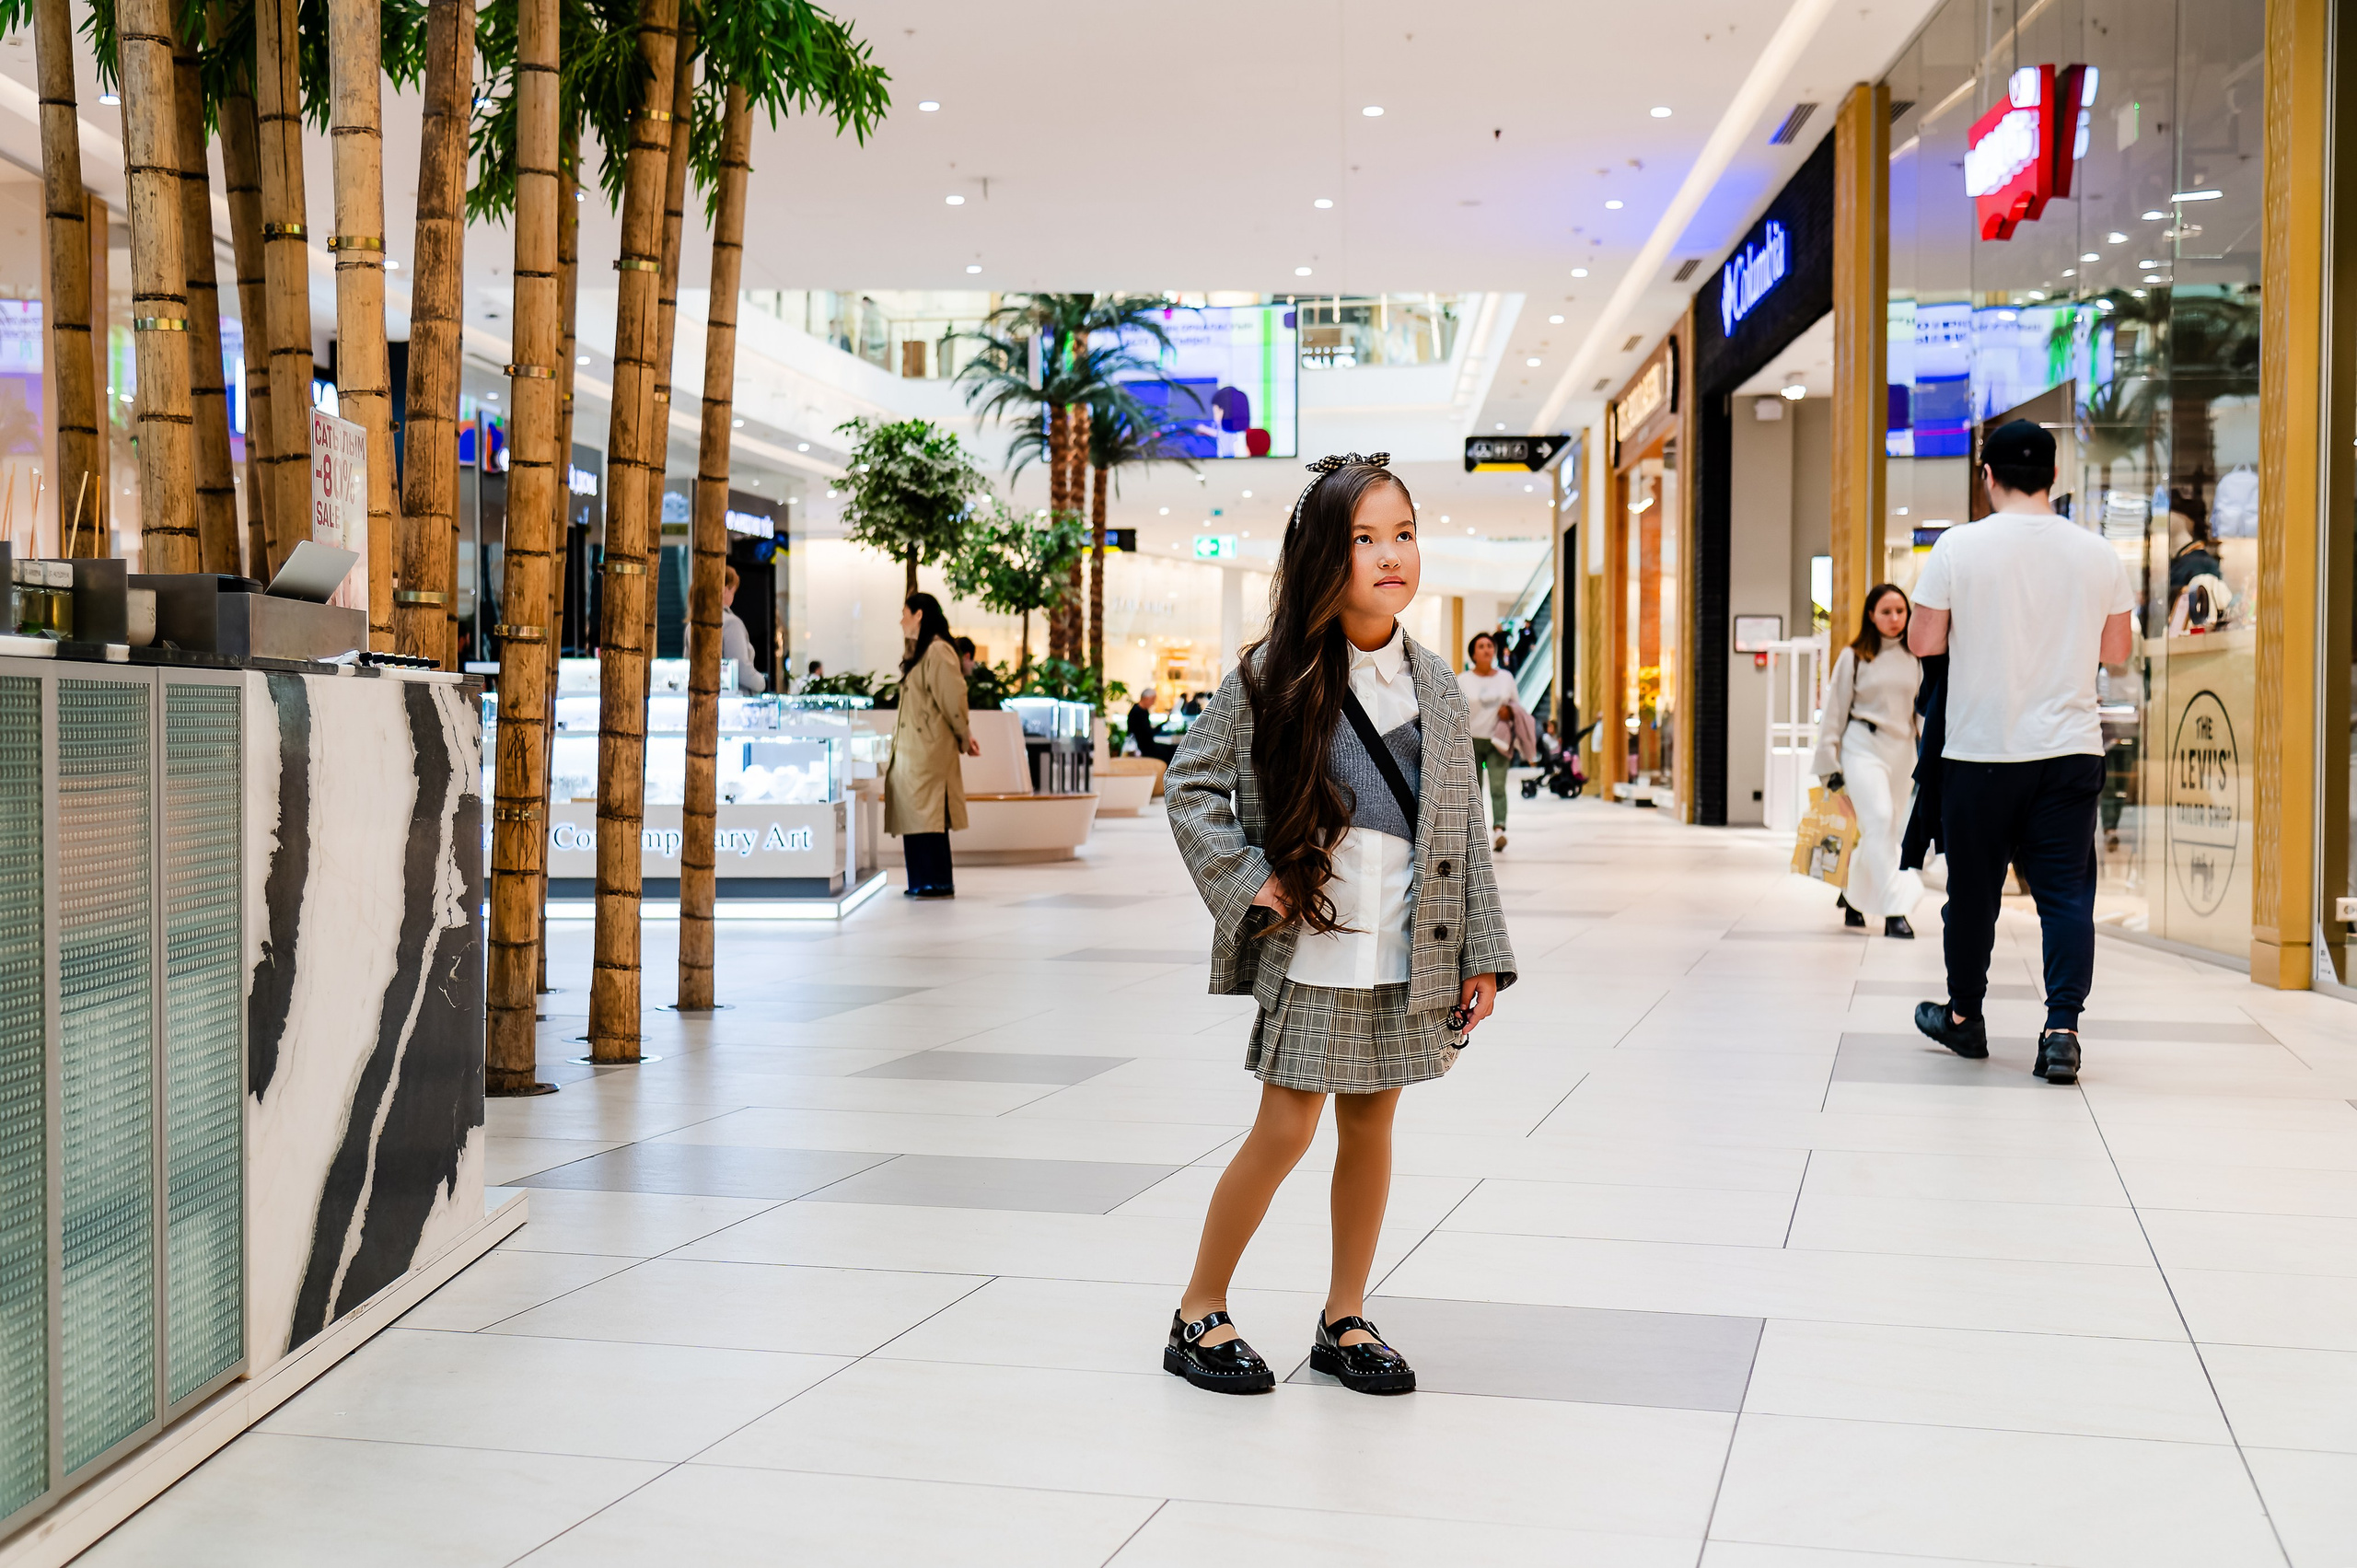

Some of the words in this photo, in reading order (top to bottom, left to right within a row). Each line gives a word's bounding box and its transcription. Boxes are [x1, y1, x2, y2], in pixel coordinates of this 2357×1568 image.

[1732, 219, 1785, 321] Columbia
[315, 420, 366, 460] САТЫЛЫМ
[316, 453, 355, 505] -80%
[317, 500, 341, 528] SALE
[2196, 716, 2212, 739] THE
[764, 826, 812, 849] Art
